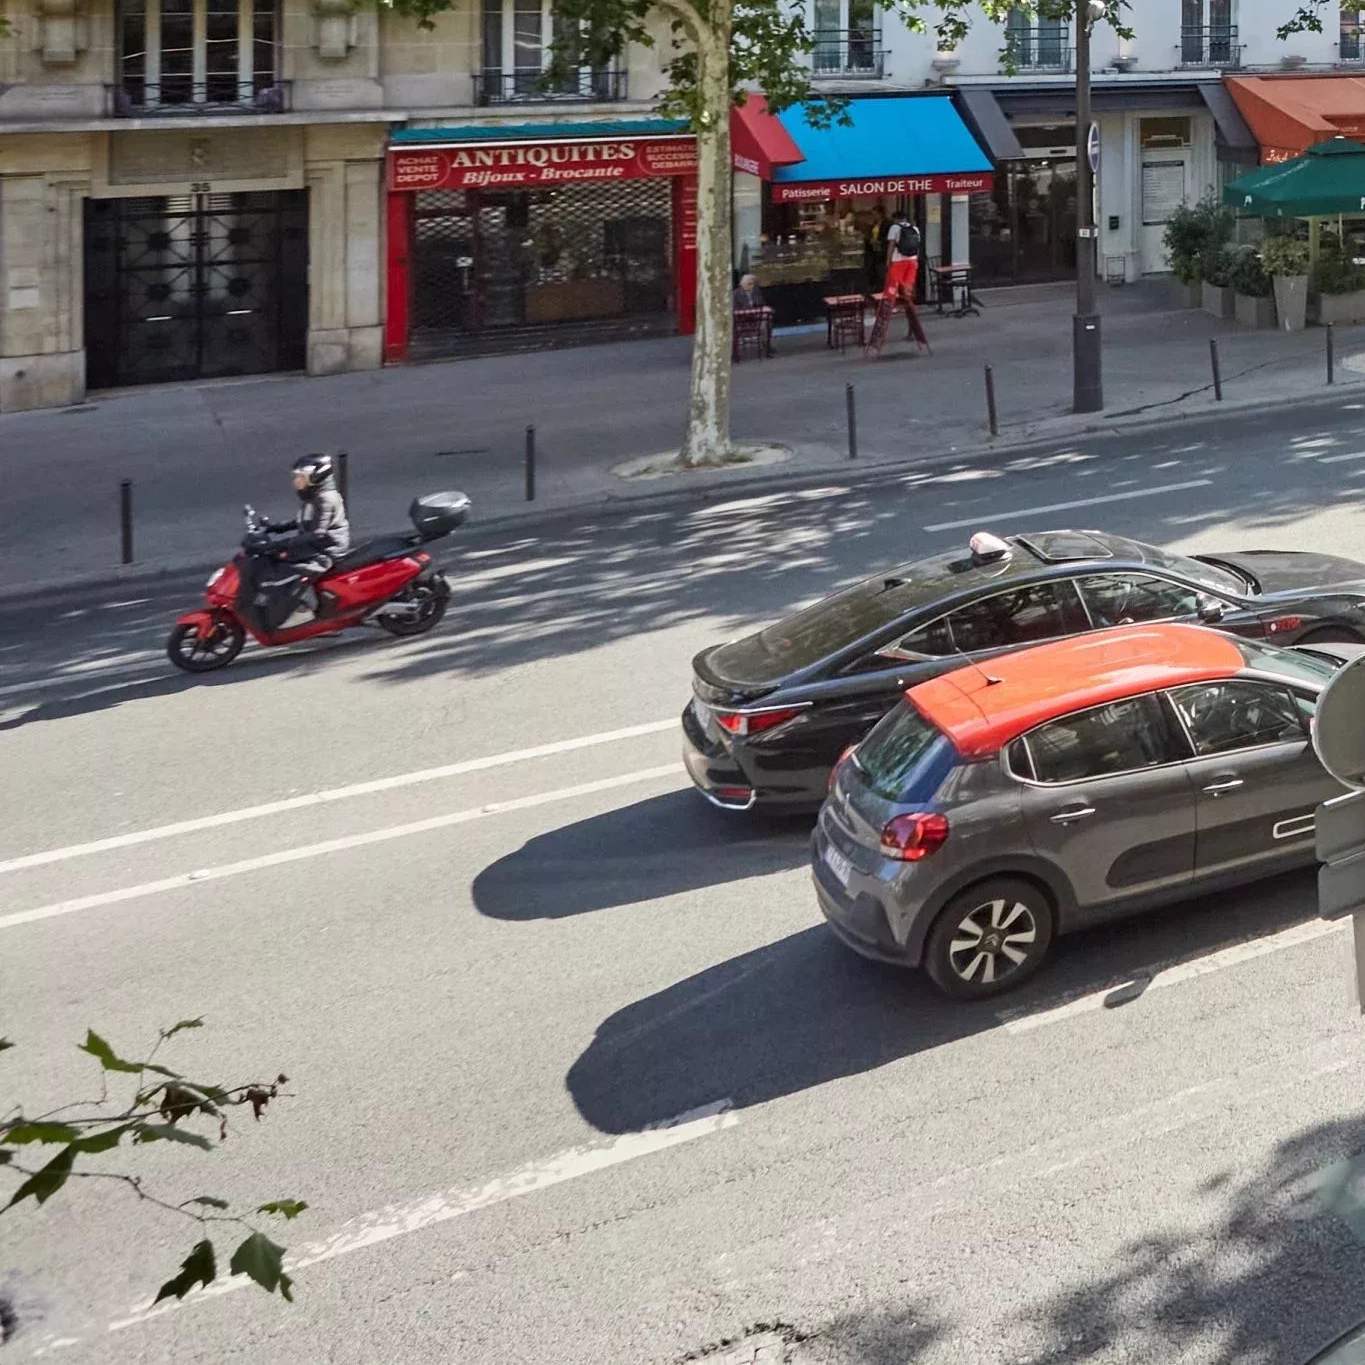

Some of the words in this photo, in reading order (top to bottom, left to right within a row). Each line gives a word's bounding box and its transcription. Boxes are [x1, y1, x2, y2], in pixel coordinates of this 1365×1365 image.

[396, 156, 439, 165] ACHAT
[451, 143, 636, 168] ANTIQUITES
[396, 164, 439, 174] VENTE
[462, 171, 526, 186] Bijoux
[541, 166, 625, 180] Brocante
[396, 173, 439, 182] DEPOT
[839, 181, 885, 196] SALON
[888, 180, 905, 192] DE
[945, 178, 983, 189] Traiteur
